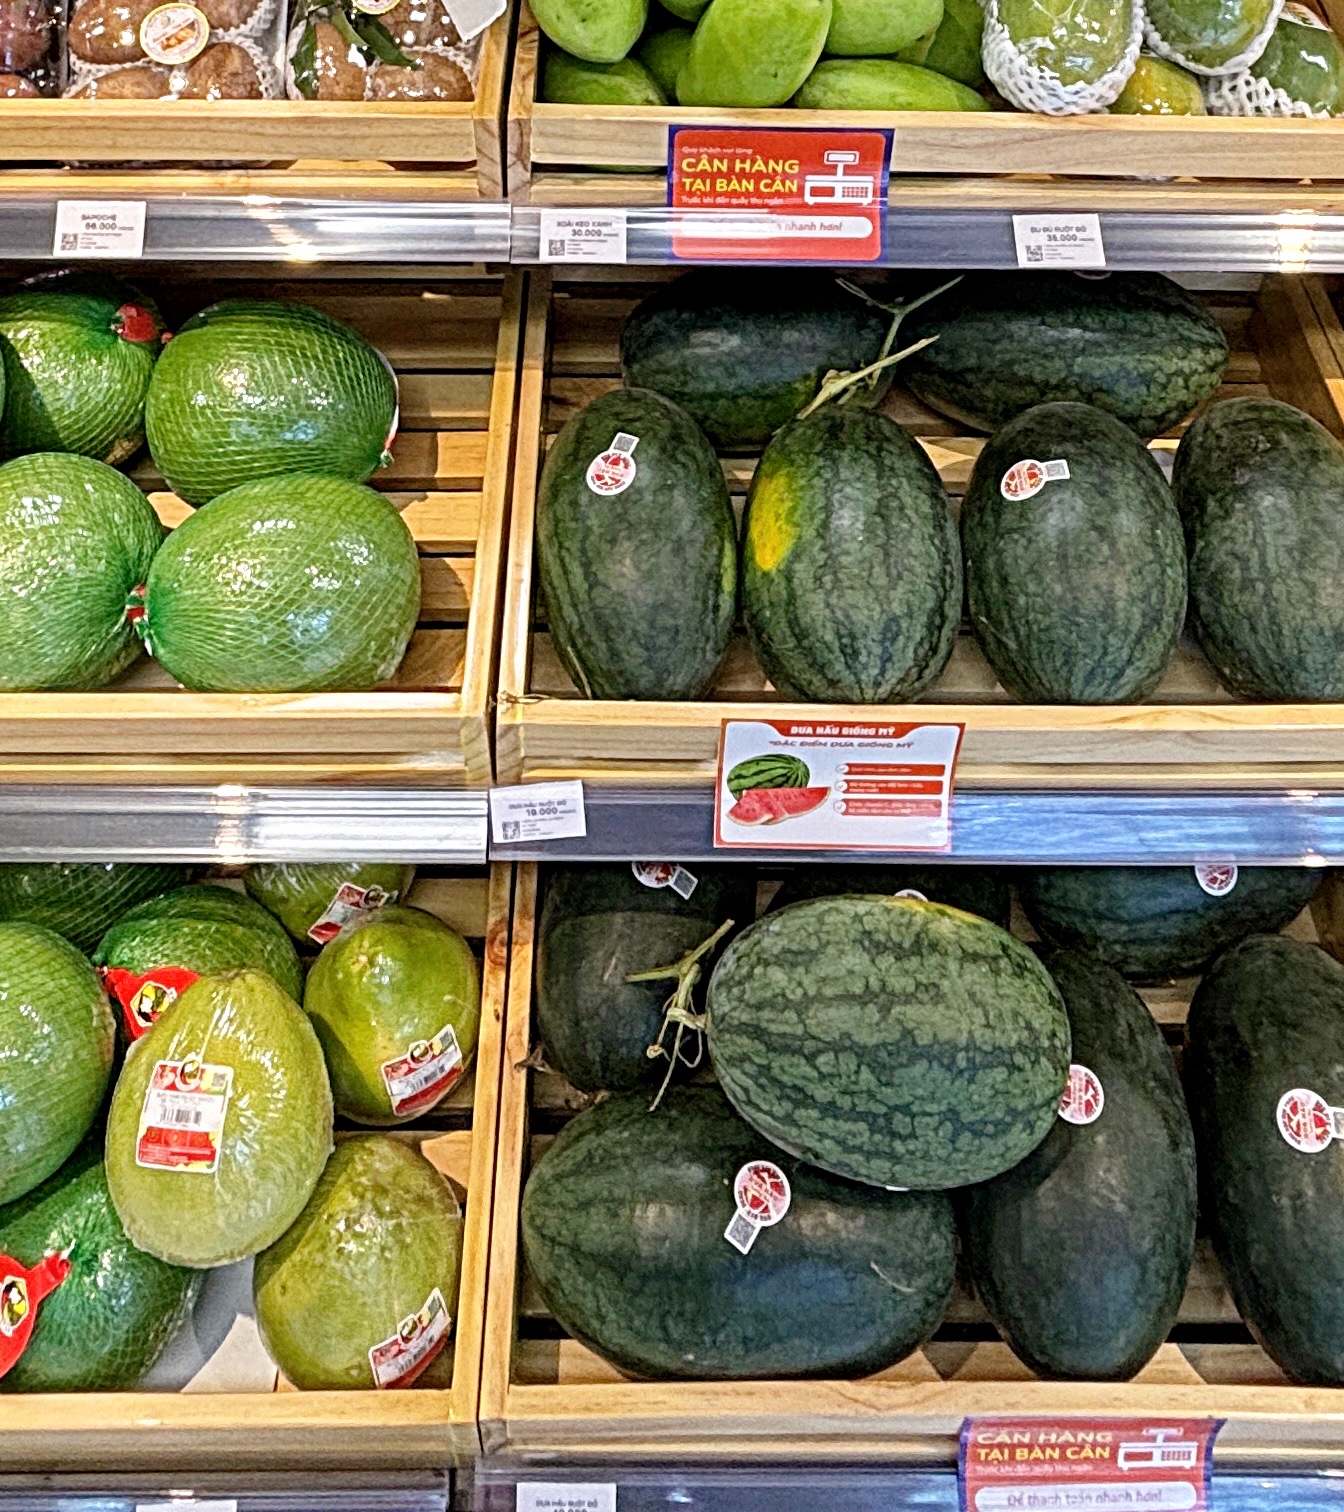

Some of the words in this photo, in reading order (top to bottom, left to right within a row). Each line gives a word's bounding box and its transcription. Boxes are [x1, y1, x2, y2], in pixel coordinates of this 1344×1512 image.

[681, 153, 729, 173] CÂN
[734, 154, 800, 174] HÀNG
[681, 178, 711, 195] TẠI
[715, 175, 755, 193] BÀN
[759, 175, 798, 193] CÂN
[1038, 1428, 1113, 1445] HÀNG
[976, 1447, 1009, 1465] TẠI
[1015, 1444, 1060, 1460] BÀN
[1065, 1443, 1111, 1460] CÂN
